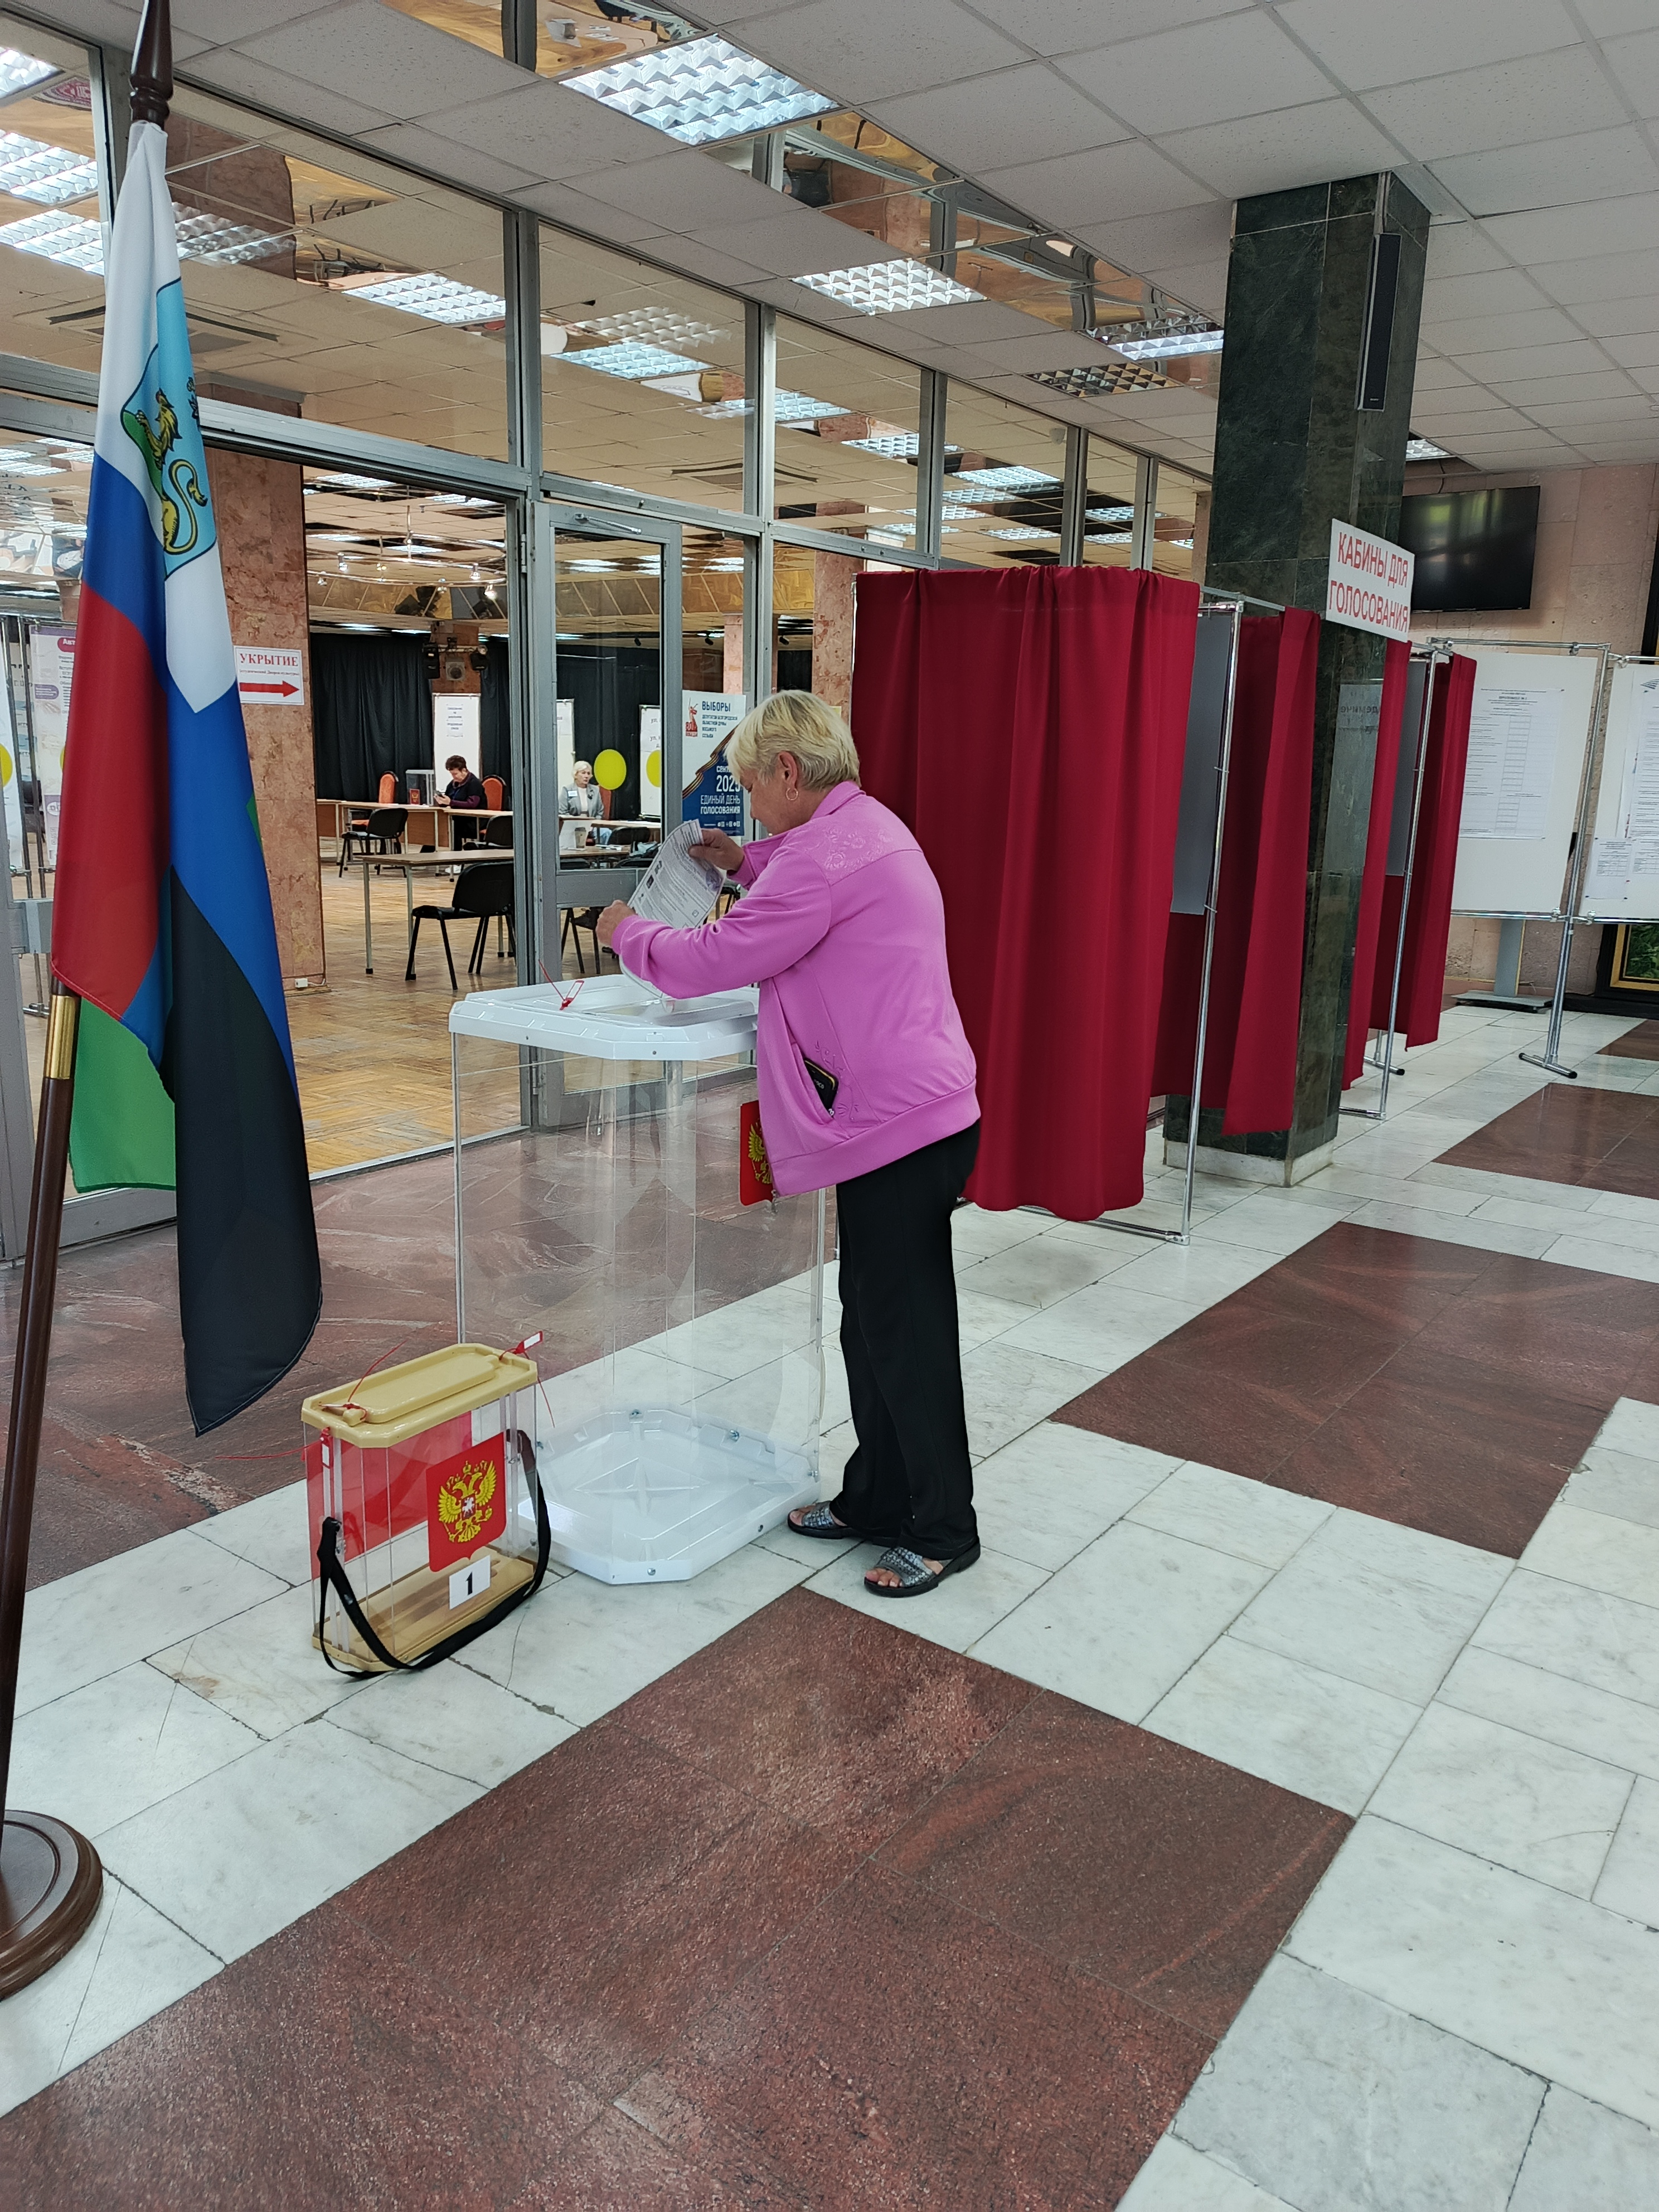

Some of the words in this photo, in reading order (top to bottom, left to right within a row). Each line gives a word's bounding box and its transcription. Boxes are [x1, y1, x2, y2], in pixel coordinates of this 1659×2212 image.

[1338, 532, 1388, 579] КАБИНЫ
[1388, 554, 1408, 589] ДЛЯ
[1329, 580, 1408, 633] ГОЛОСОВАНИЯ
[240, 653, 298, 667] УКРЫТИЕ
[702, 700, 731, 712] ВЫБОРЫ
[700, 793, 725, 804] ЕДИНЫЙ
[725, 795, 740, 805] ДЕНЬ
[700, 806, 740, 814] голосования
[465, 1571, 473, 1596] 1
